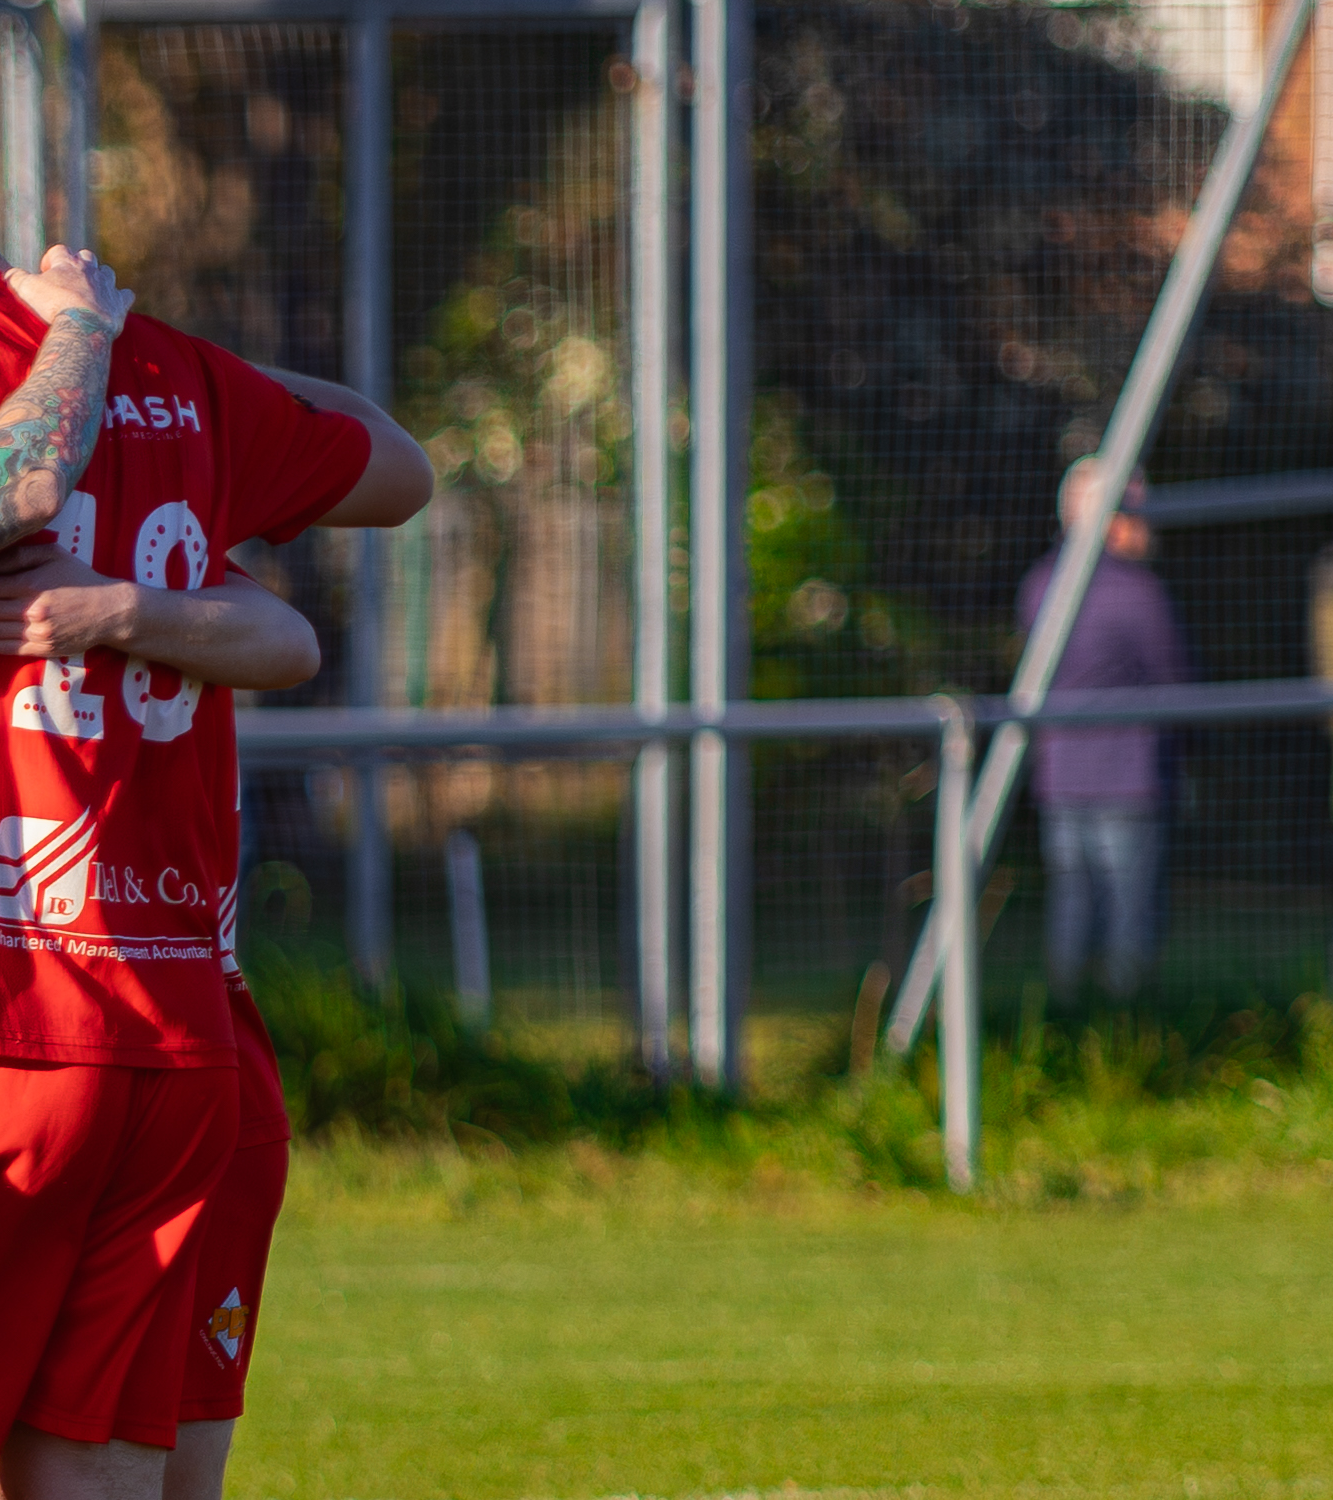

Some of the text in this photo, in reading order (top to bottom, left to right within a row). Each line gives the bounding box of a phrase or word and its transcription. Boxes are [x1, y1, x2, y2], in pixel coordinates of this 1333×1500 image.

[105, 394, 201, 433] HASH
[89, 862, 207, 907] Del & Co.
